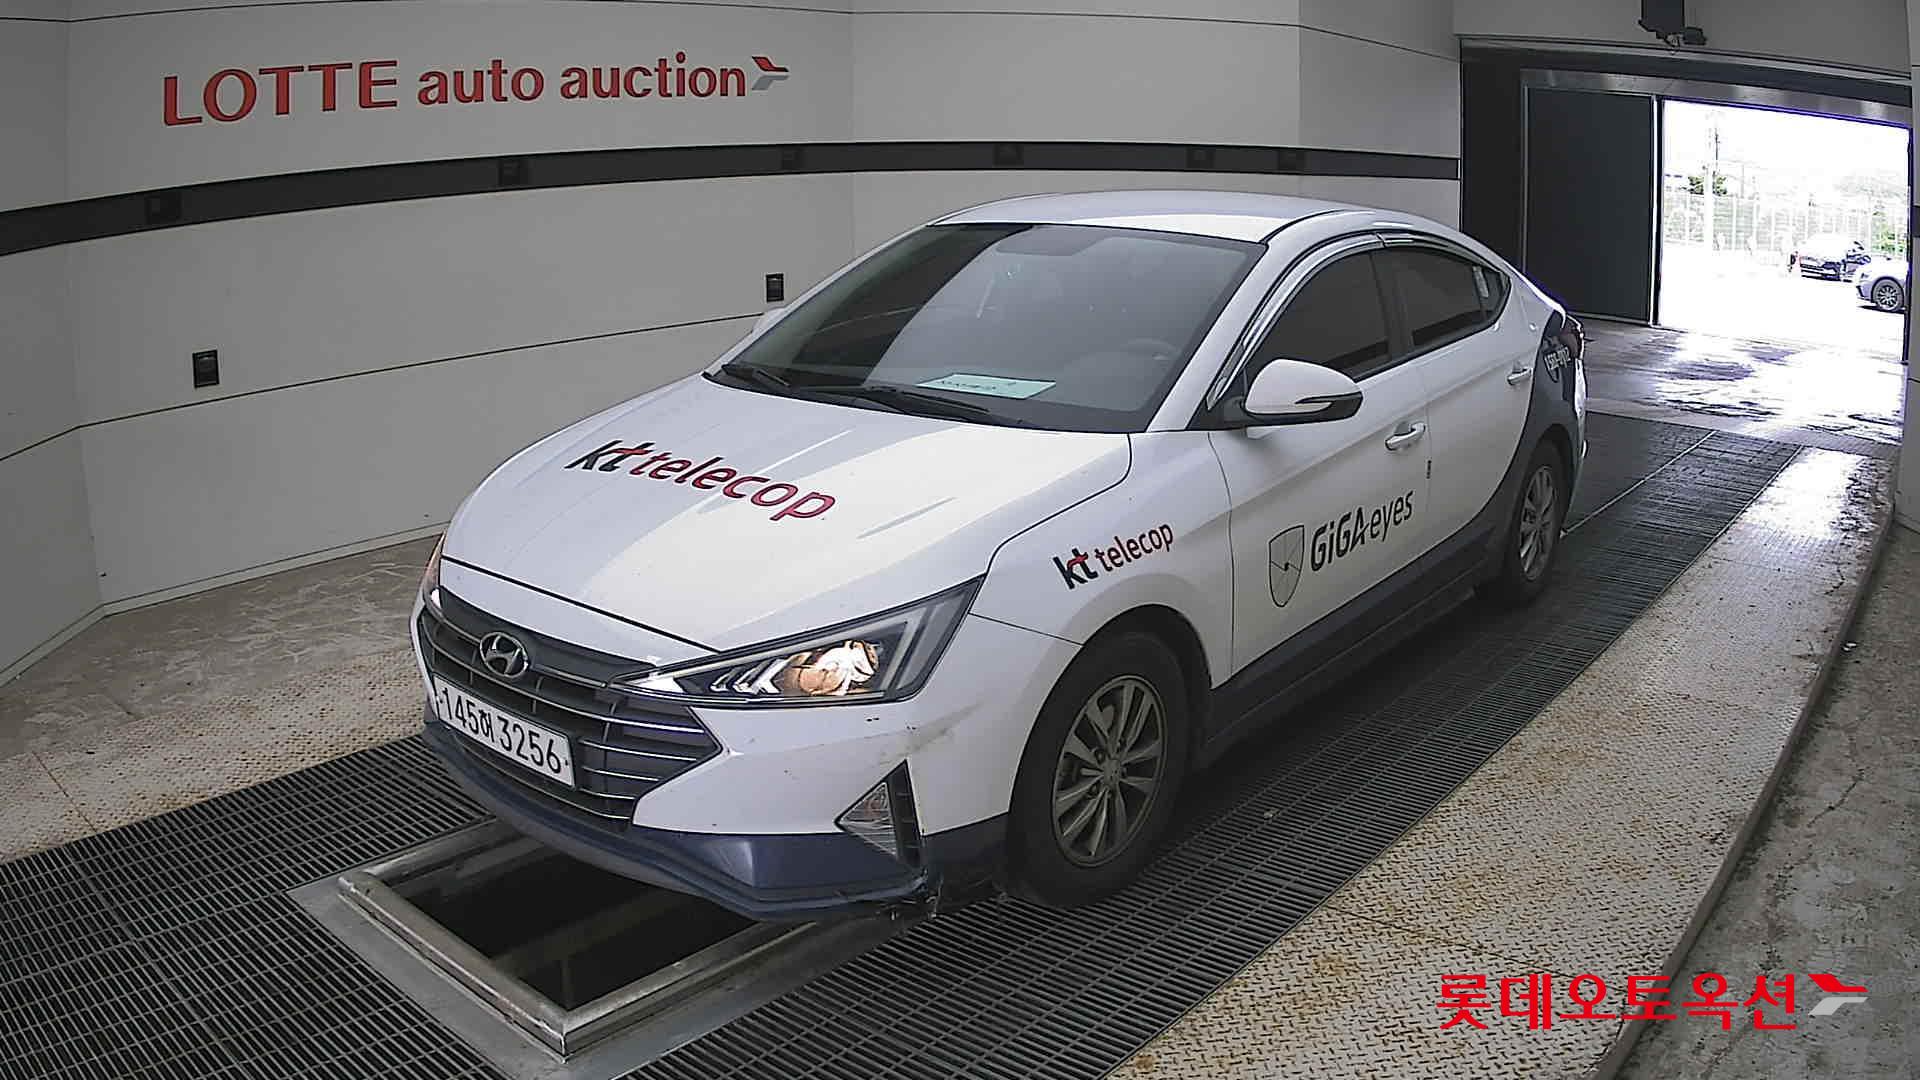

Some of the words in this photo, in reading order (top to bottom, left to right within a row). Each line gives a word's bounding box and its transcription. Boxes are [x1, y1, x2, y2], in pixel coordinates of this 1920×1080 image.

[163, 59, 398, 126] LOTTE
[416, 59, 545, 105] auto
[560, 51, 746, 99] auction
[564, 440, 655, 472] kt
[629, 452, 836, 521] telecop
[1052, 548, 1098, 590] kt
[1095, 521, 1174, 573] telecop
[497, 715, 561, 774] 3256
